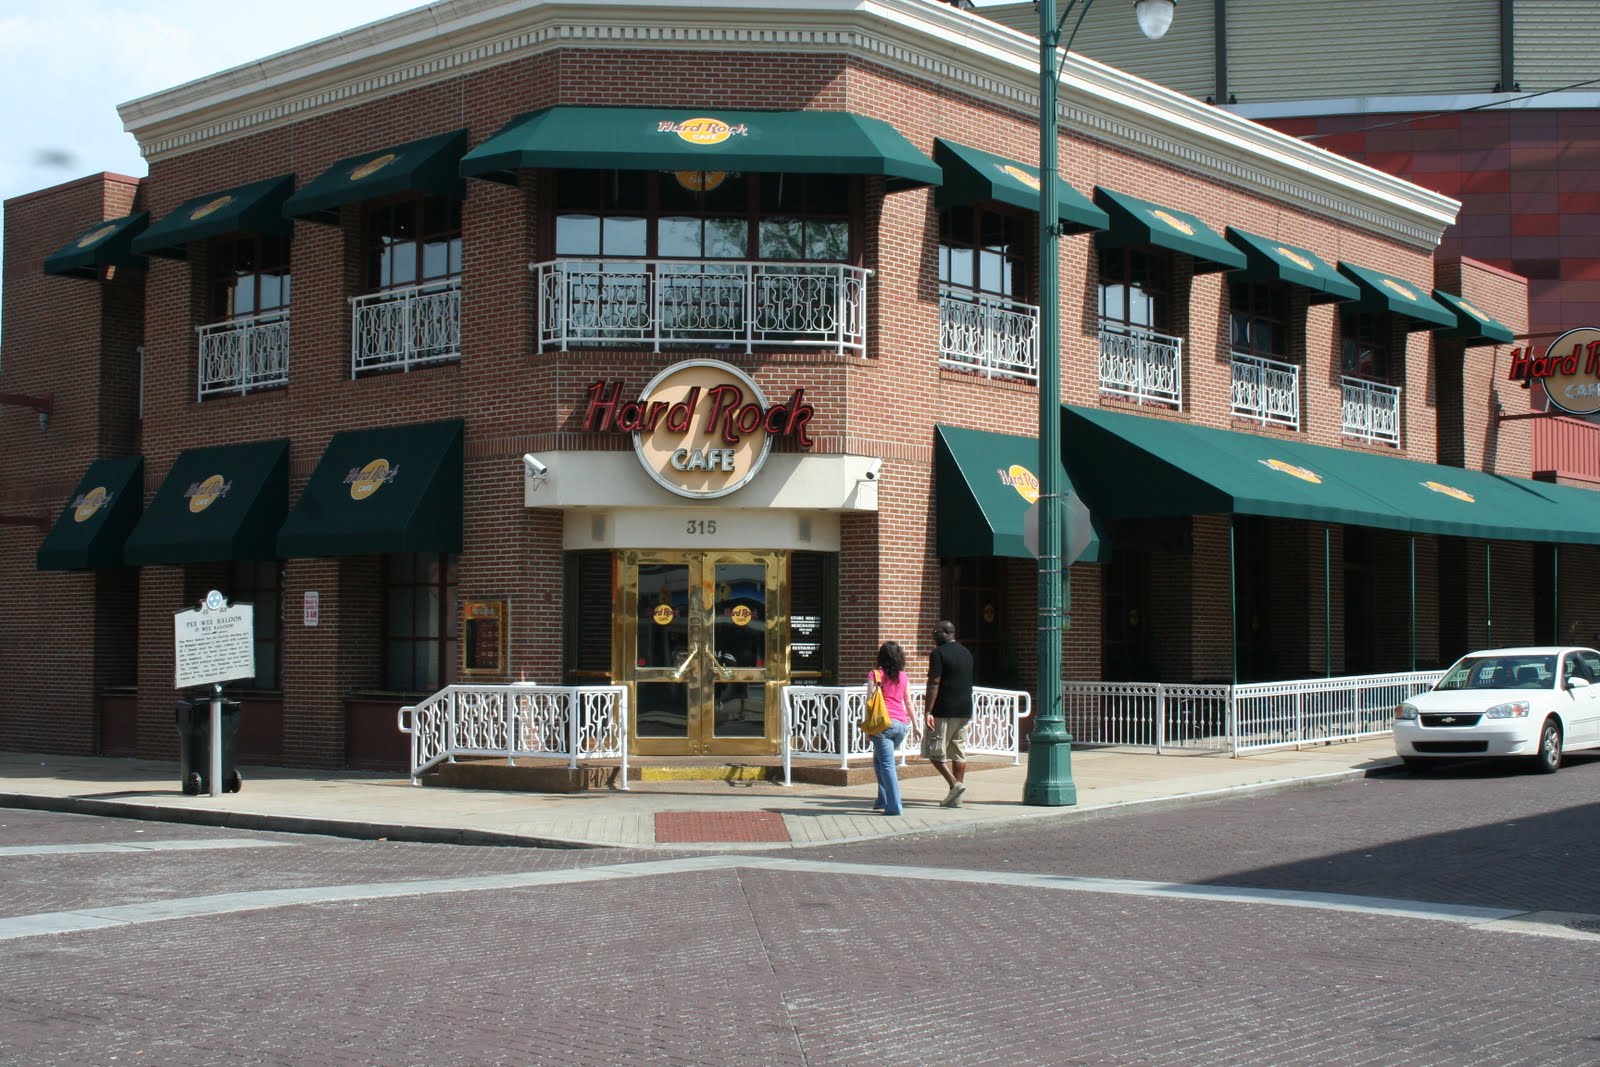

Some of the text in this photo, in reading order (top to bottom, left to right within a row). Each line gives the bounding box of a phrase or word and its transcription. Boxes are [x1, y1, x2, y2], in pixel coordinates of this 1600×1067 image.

[657, 121, 748, 136] Hard Rock
[1508, 344, 1581, 380] Hard
[584, 381, 814, 446] Hard Rock
[670, 448, 735, 472] CAFE
[686, 520, 717, 535] 315
